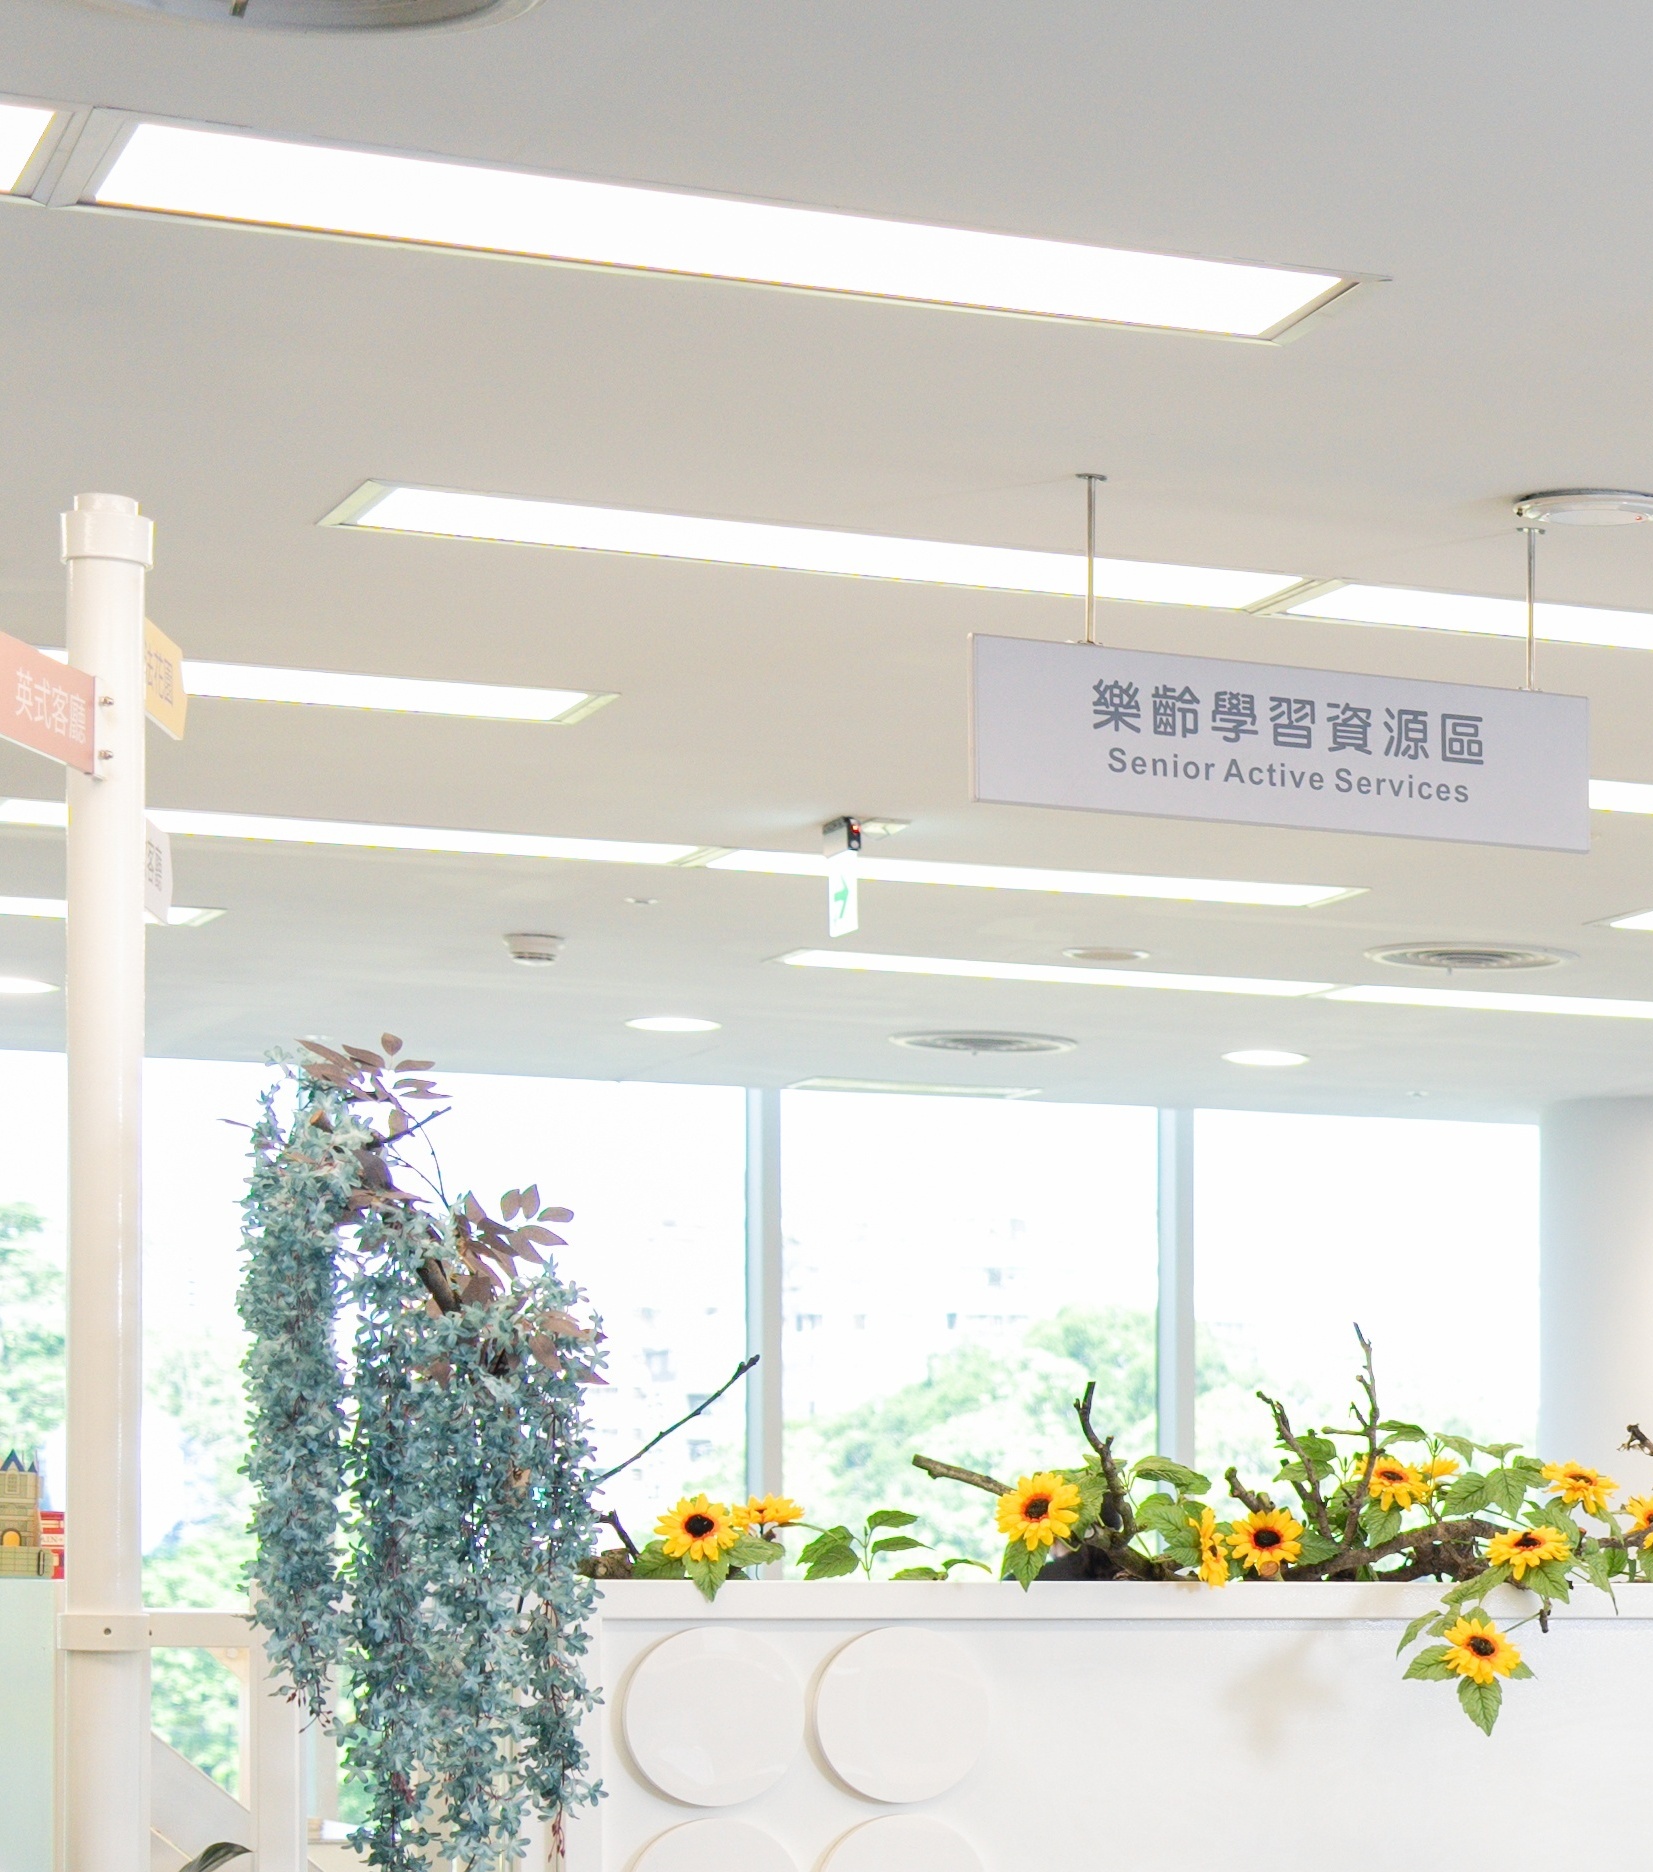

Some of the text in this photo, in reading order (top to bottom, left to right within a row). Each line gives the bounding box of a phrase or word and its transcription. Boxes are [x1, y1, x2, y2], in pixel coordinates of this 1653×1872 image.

[15, 667, 87, 744] 英式客廳
[1092, 678, 1485, 766] 樂齡學習資源區
[1107, 747, 1471, 804] Senior Active Services
